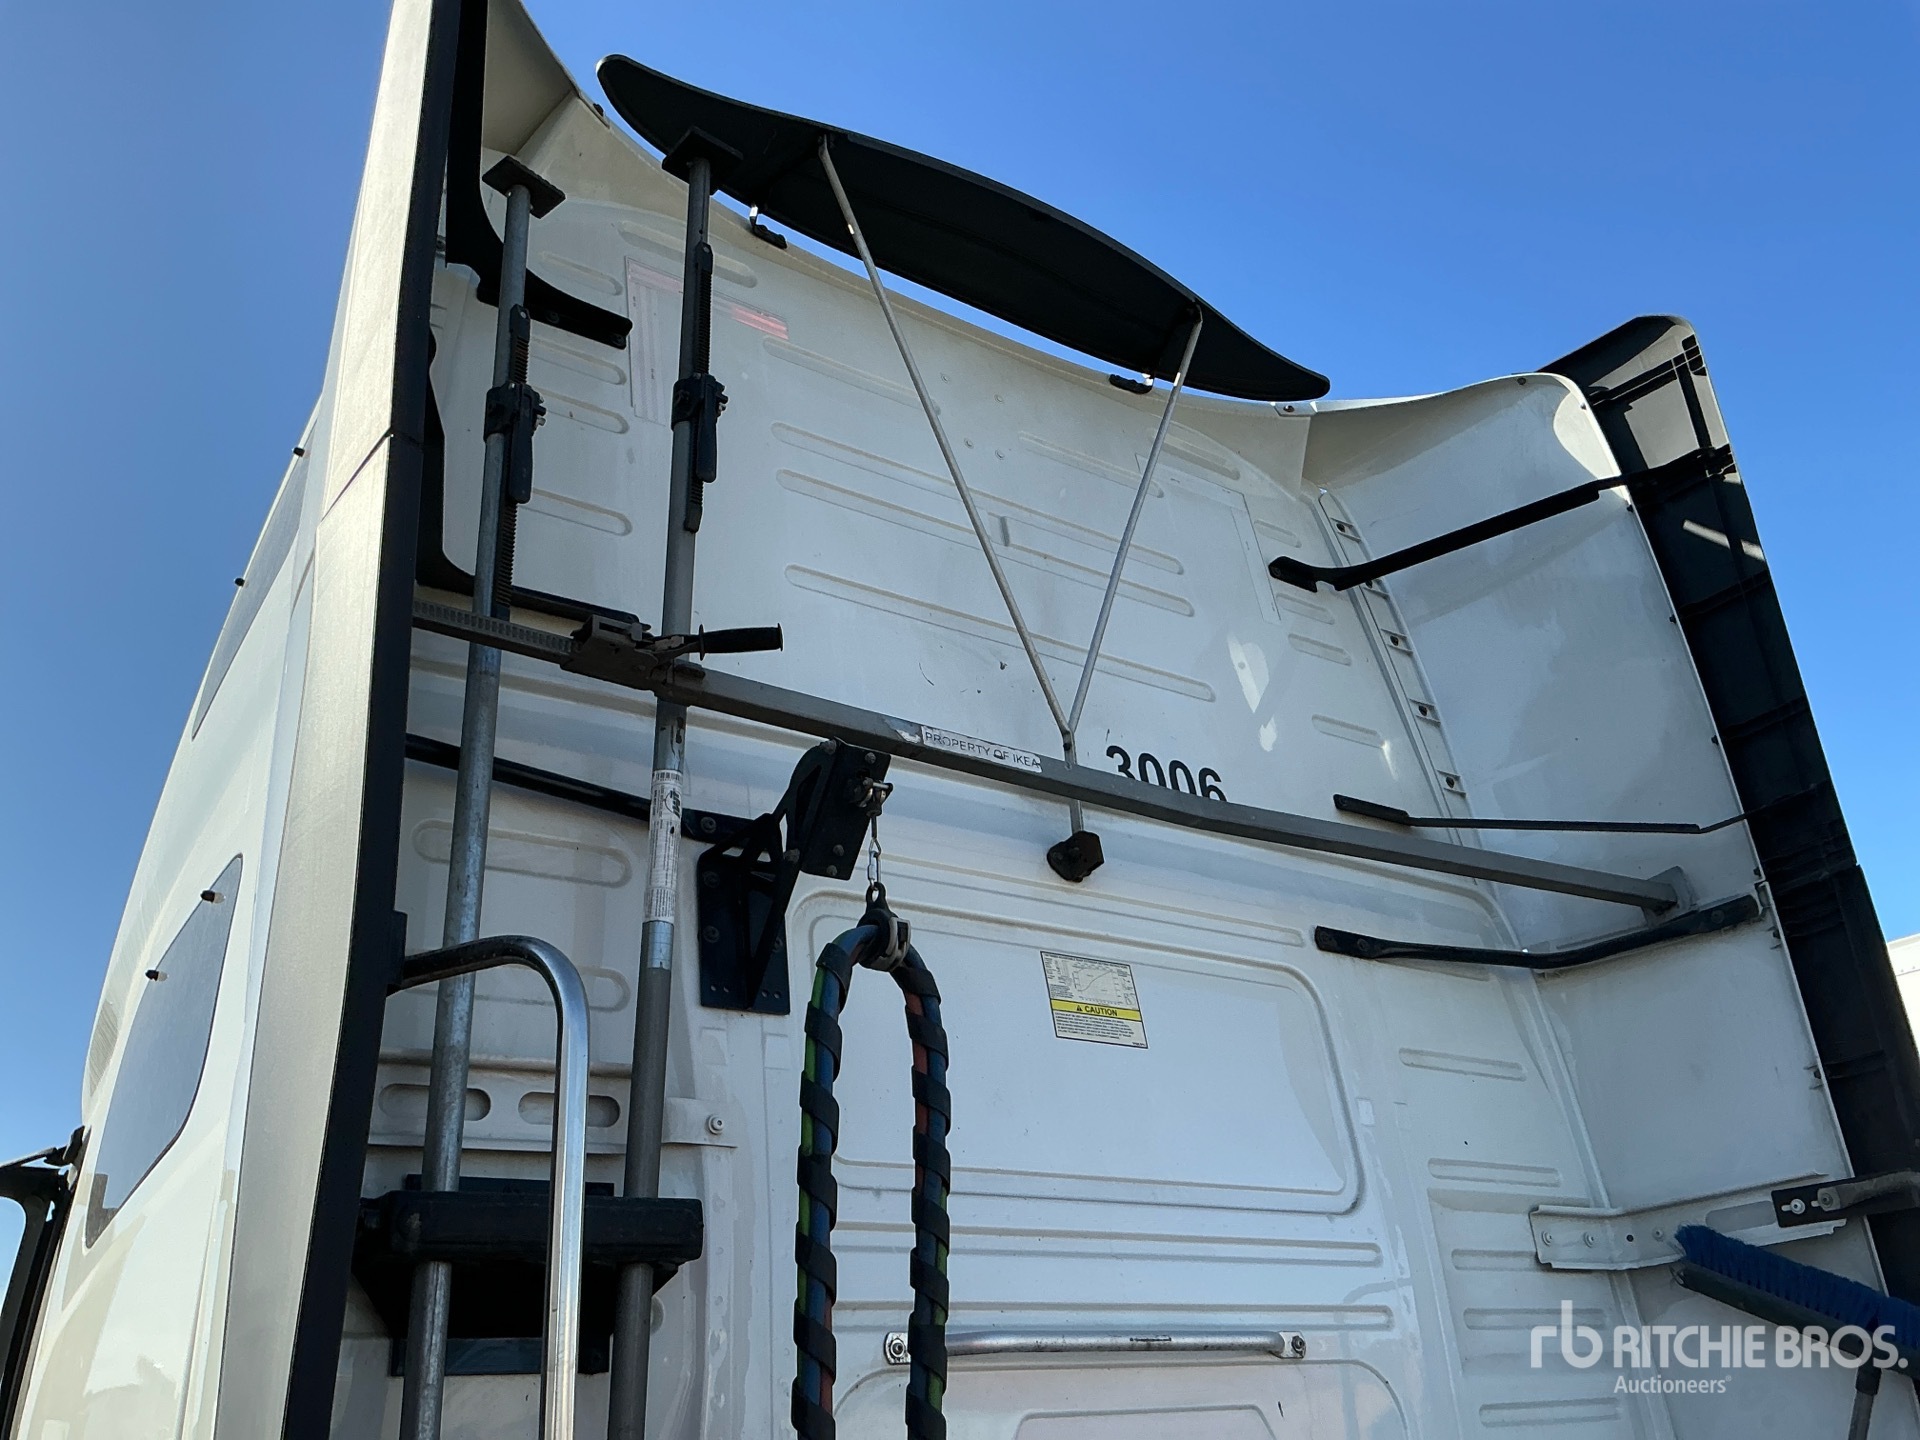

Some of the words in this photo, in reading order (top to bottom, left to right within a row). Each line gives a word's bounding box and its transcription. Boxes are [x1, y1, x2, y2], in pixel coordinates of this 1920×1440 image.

[925, 731, 991, 756] PROPERTY
[993, 749, 1009, 760] OF
[1012, 754, 1041, 768] IKEA
[1106, 745, 1228, 802] 3006
[1084, 1005, 1118, 1017] CAUTION
